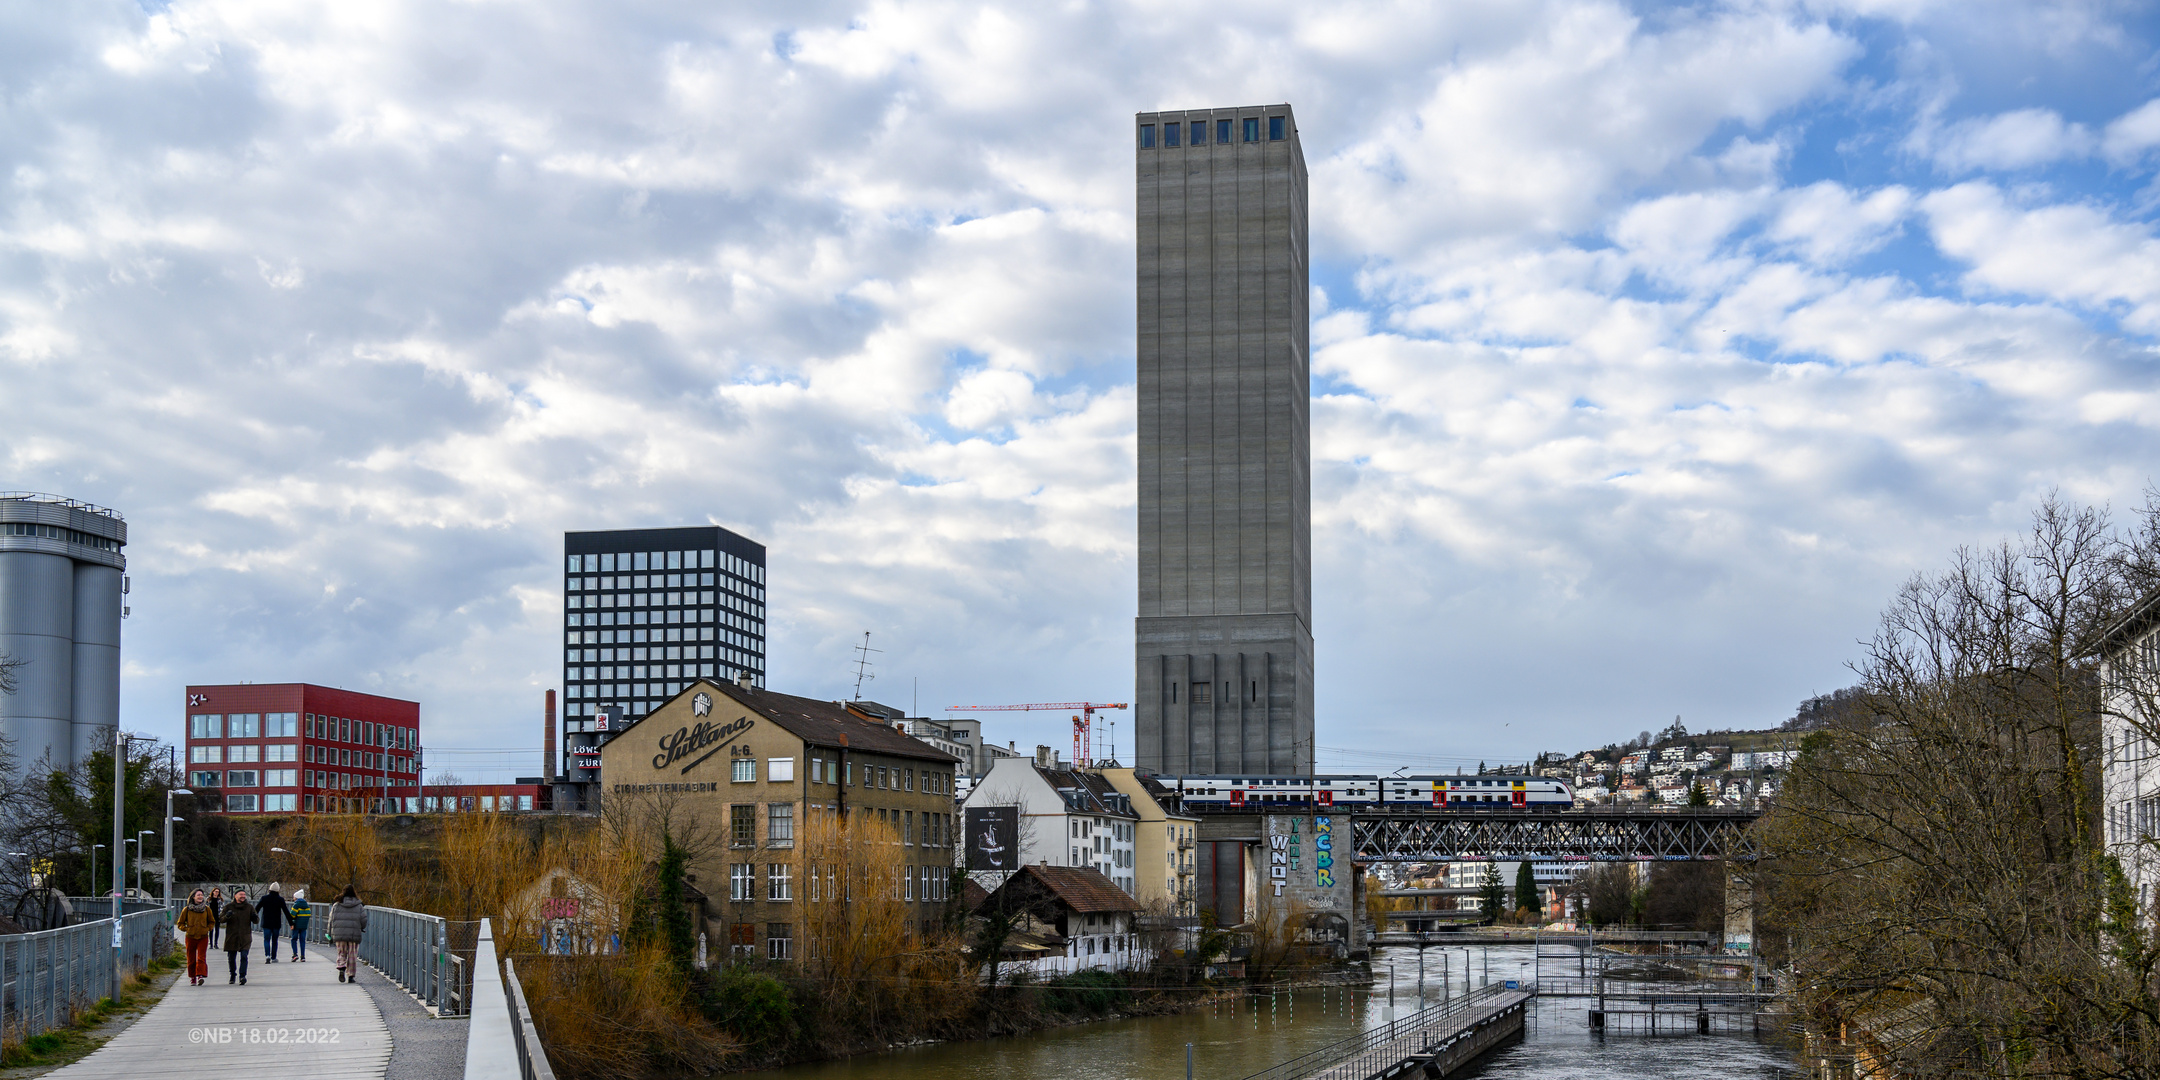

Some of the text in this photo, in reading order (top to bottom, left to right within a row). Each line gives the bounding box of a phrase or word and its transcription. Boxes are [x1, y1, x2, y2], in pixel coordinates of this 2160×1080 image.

[190, 694, 207, 706] XL
[652, 715, 755, 776] Sultana
[614, 782, 718, 794] CIGARETTENFABRIK
[1269, 834, 1290, 897] WNOT
[1315, 815, 1336, 888] KCBR
